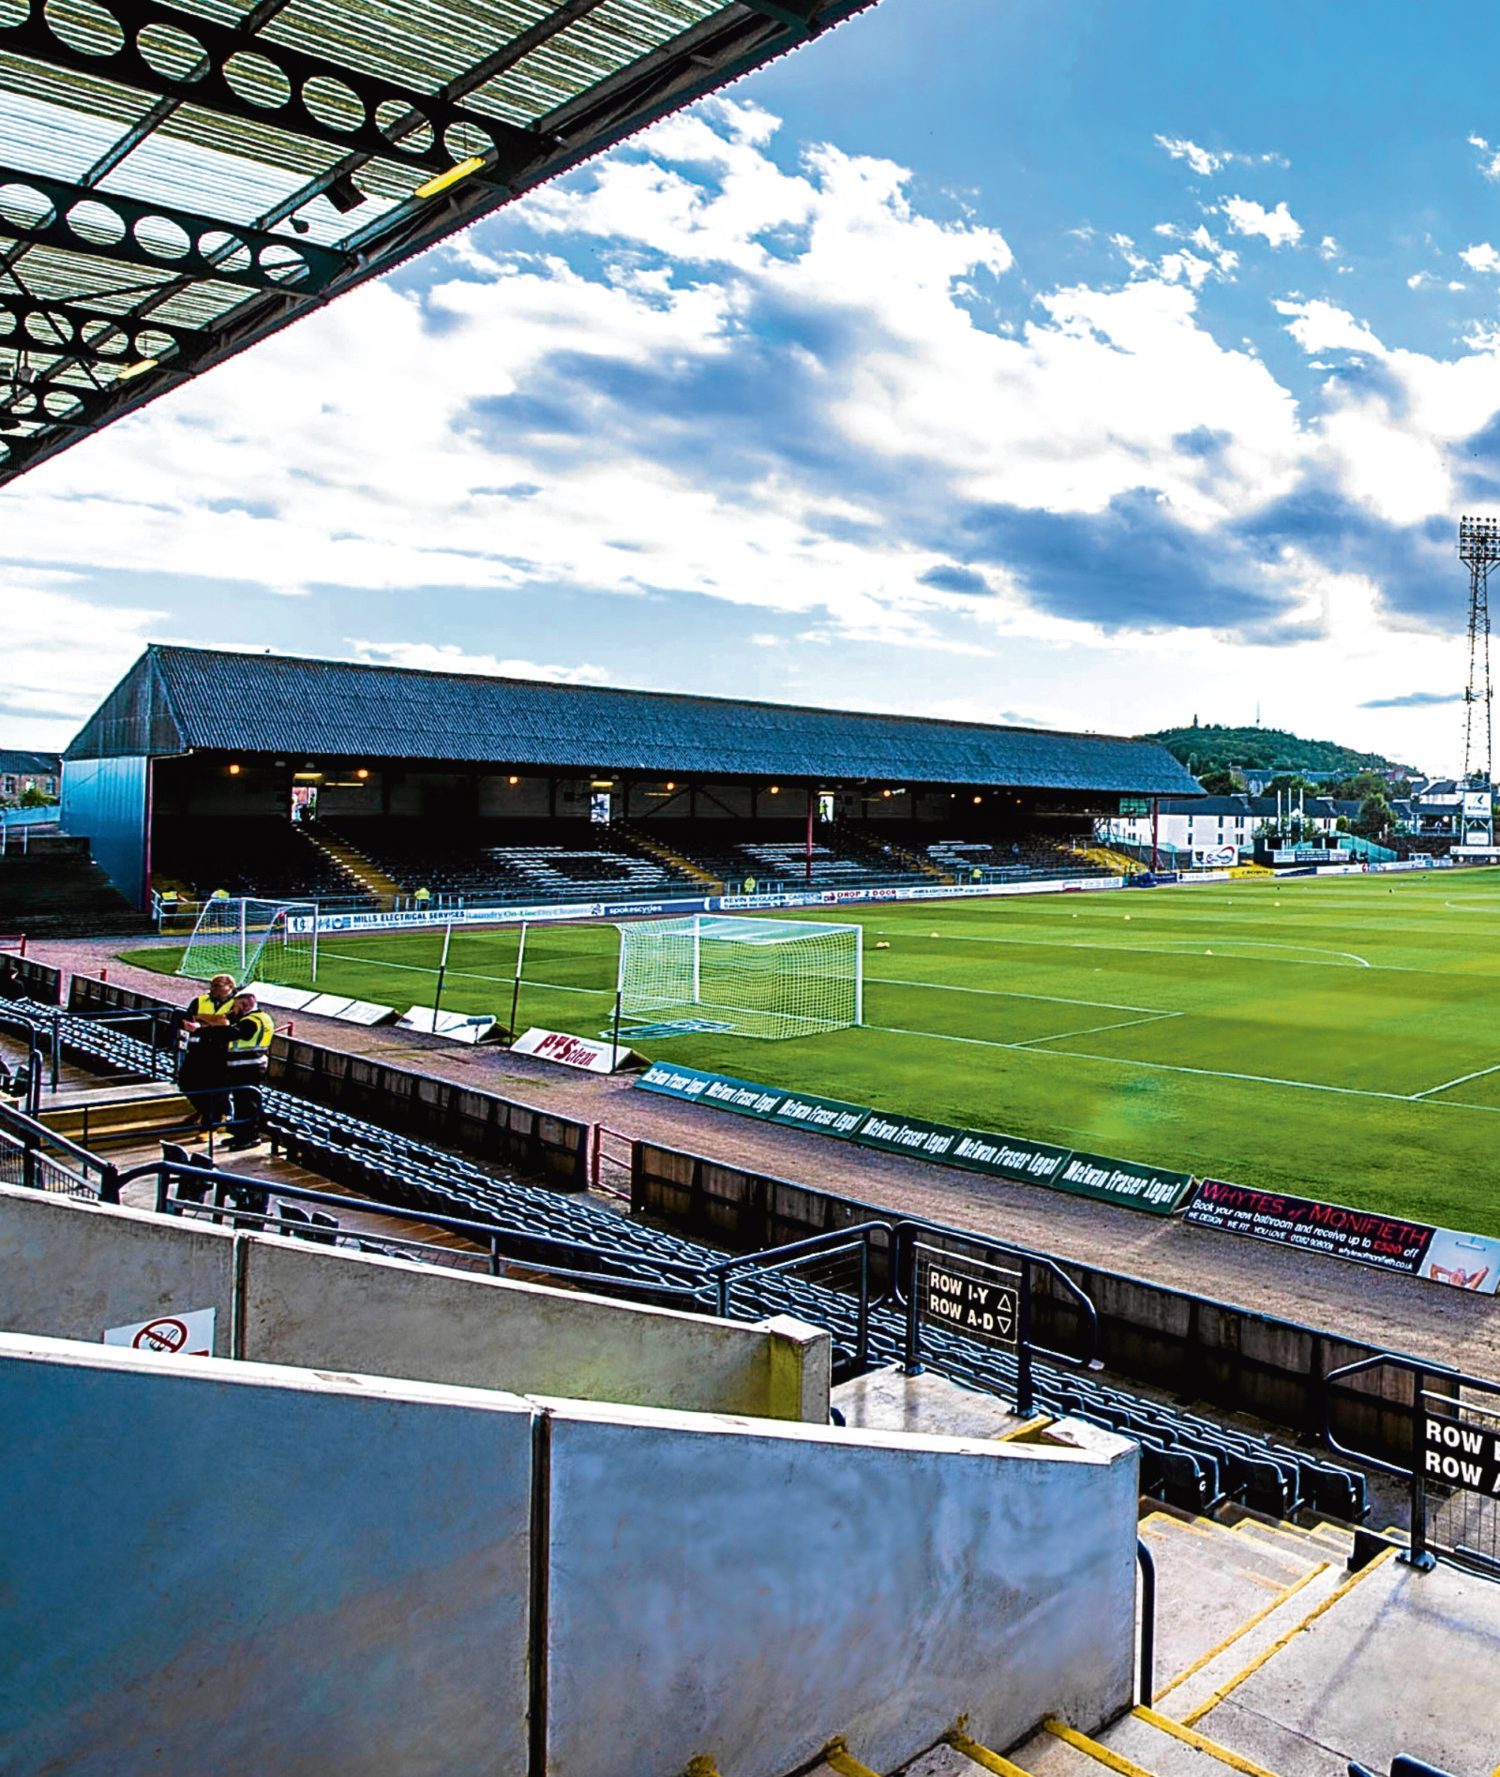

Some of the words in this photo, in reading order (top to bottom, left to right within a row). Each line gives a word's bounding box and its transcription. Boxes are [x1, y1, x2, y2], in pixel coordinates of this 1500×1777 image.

[353, 914, 377, 923] MILLS
[381, 912, 427, 922] ELECTRICAL
[777, 1099, 813, 1119] McEwan
[808, 1106, 839, 1125] Fraser
[832, 1111, 863, 1132] Legal
[861, 1117, 899, 1140] McEwan
[894, 1125, 928, 1147] Fraser
[923, 1132, 955, 1154] Legal
[954, 1138, 1001, 1162] McEwan
[992, 1147, 1031, 1170] Fraser
[1029, 1152, 1063, 1177] Legal
[1063, 1160, 1112, 1188] McEwan
[1105, 1169, 1148, 1195] Fraser
[1143, 1177, 1181, 1205] Legal
[1192, 1198, 1213, 1212] Book
[1215, 1206, 1234, 1216] your
[1233, 1210, 1253, 1220] new
[1253, 1213, 1294, 1230] bathroom
[1294, 1222, 1312, 1234] and
[1313, 1227, 1347, 1242] receive
[1347, 1234, 1360, 1246] up
[1361, 1237, 1371, 1249] to
[1403, 1248, 1420, 1259] off
[1202, 1181, 1286, 1214] WHYTES
[1308, 1204, 1430, 1247] MONIFIETH
[930, 1272, 962, 1296] ROW
[930, 1294, 962, 1320] ROW
[967, 1309, 994, 1331] A-D
[1426, 1419, 1483, 1455] ROW
[1425, 1450, 1483, 1486] ROW
